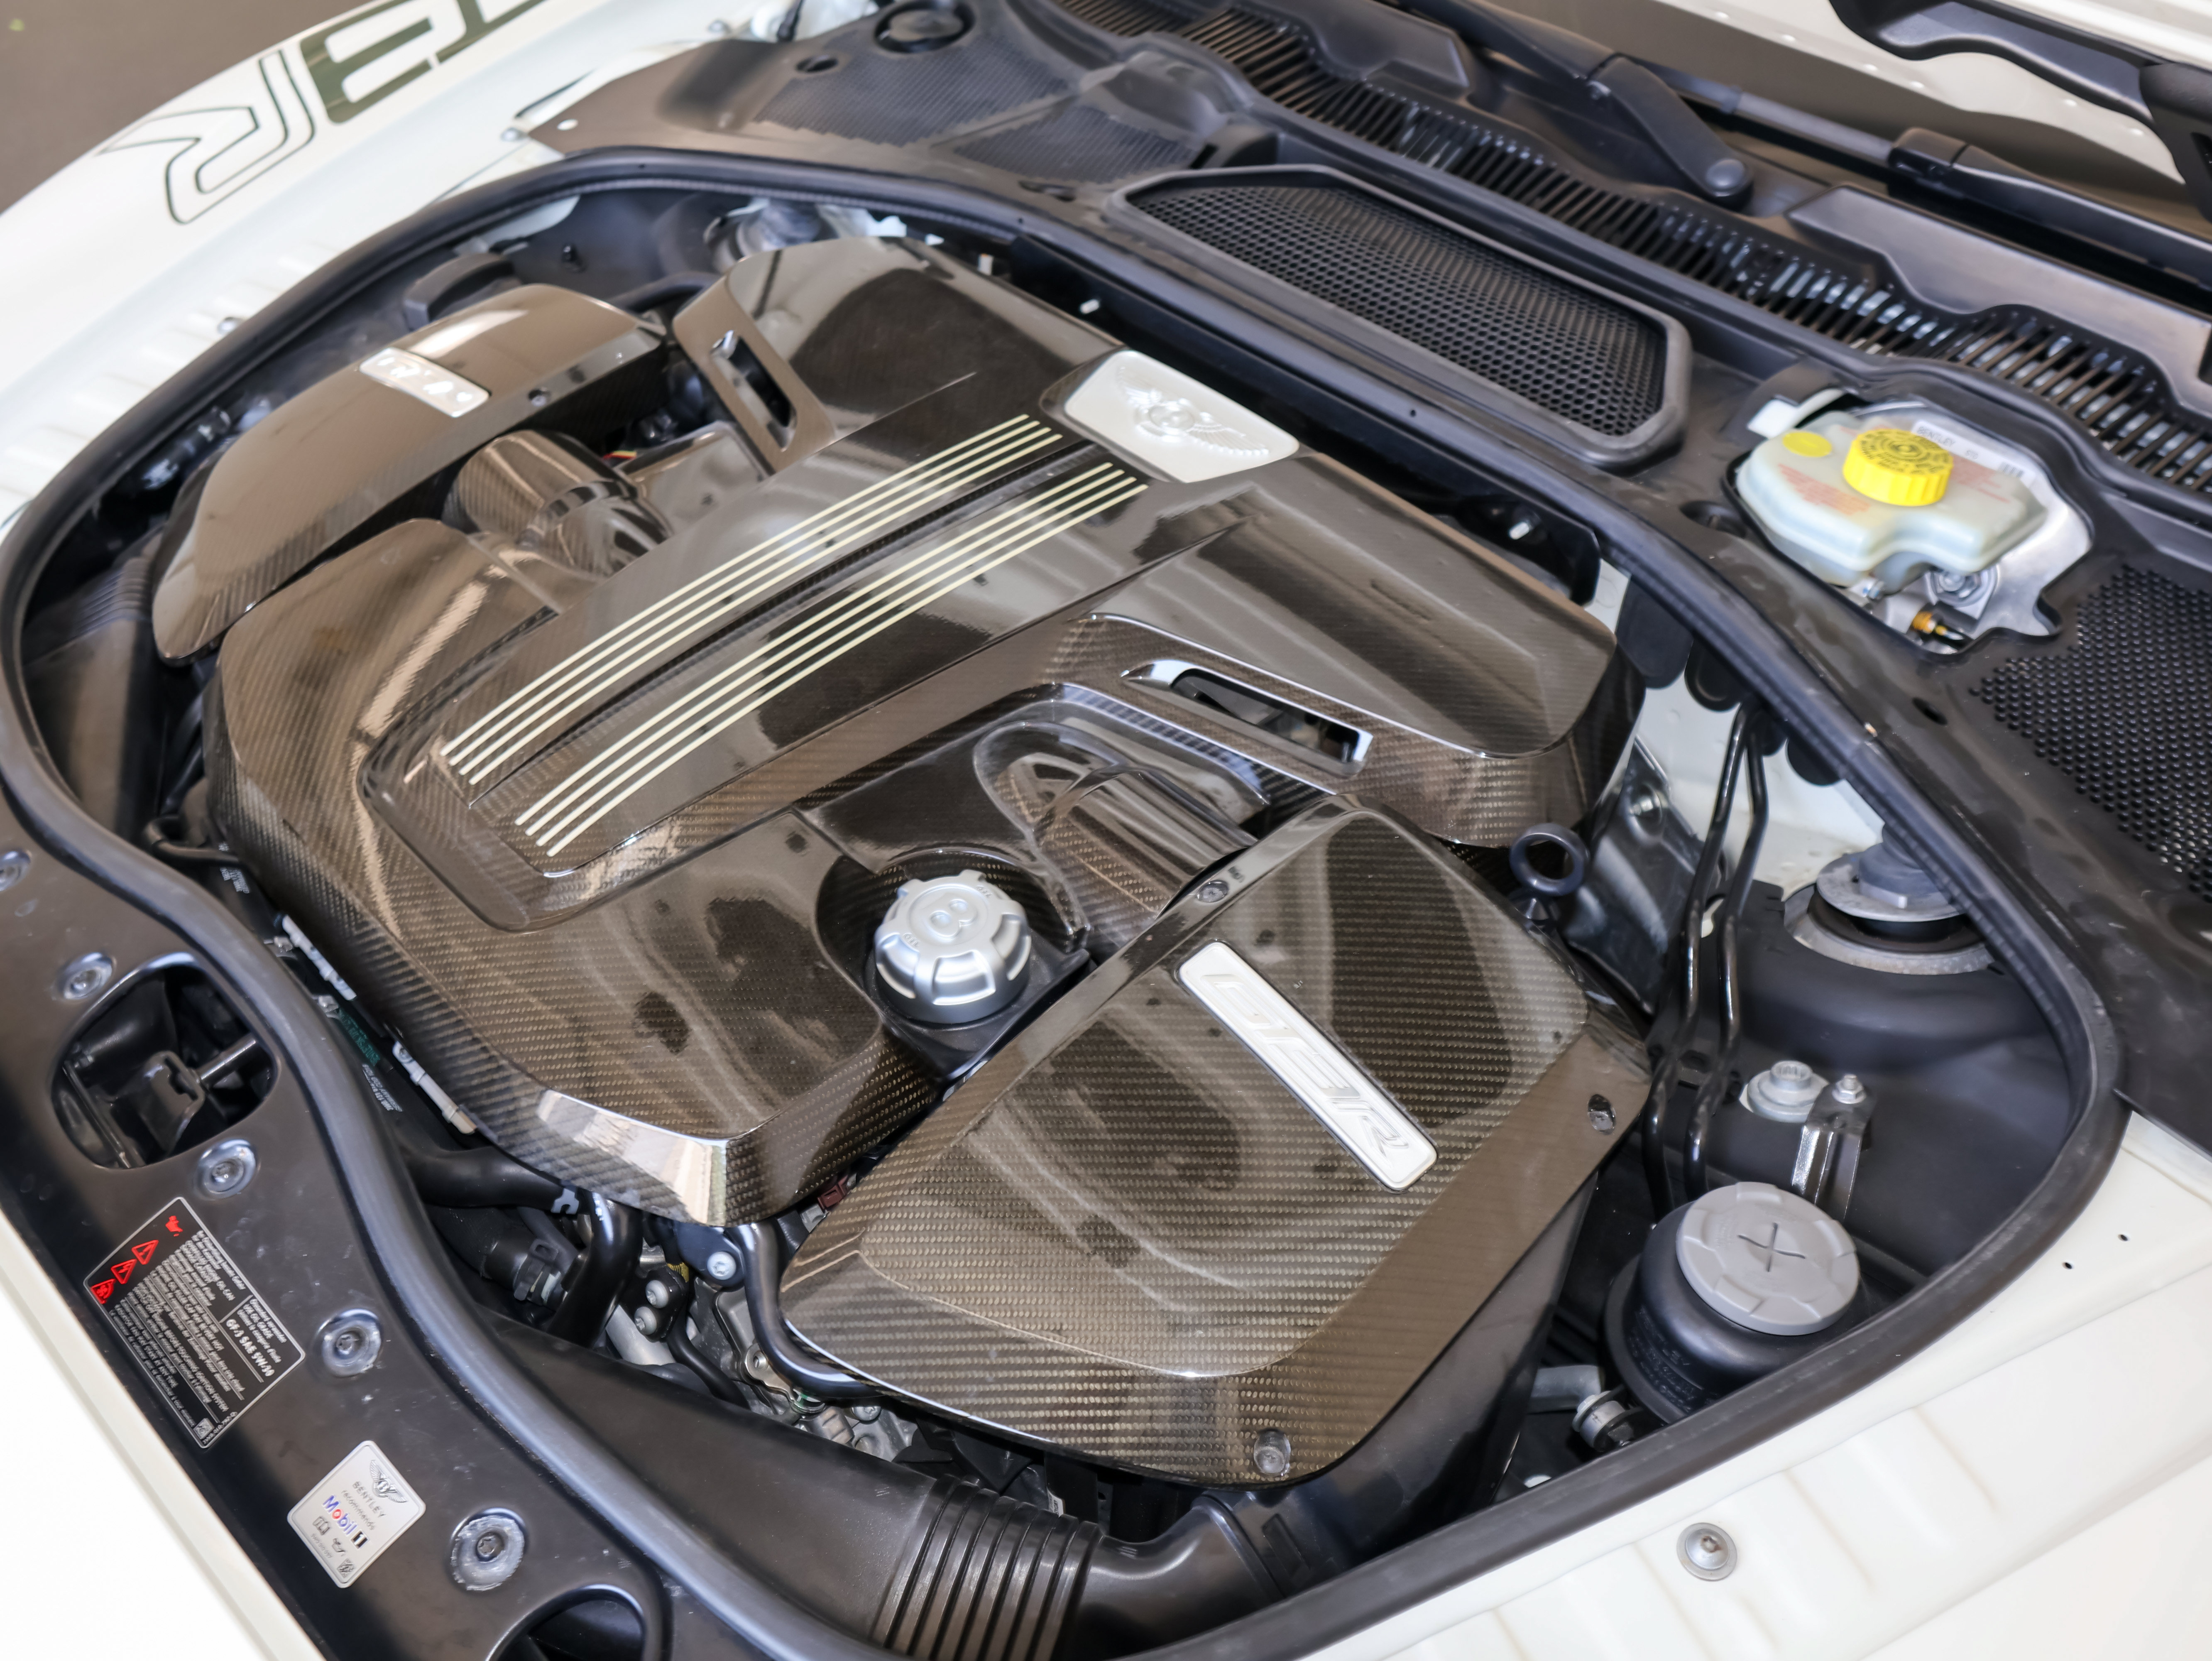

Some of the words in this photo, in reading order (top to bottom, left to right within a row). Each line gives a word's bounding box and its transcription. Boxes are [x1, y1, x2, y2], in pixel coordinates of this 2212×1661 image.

[238, 1336, 257, 1353] SAE
[323, 1495, 358, 1535] Mobil
[341, 1490, 376, 1531] recommends
[352, 1481, 387, 1518] BENTLEY
